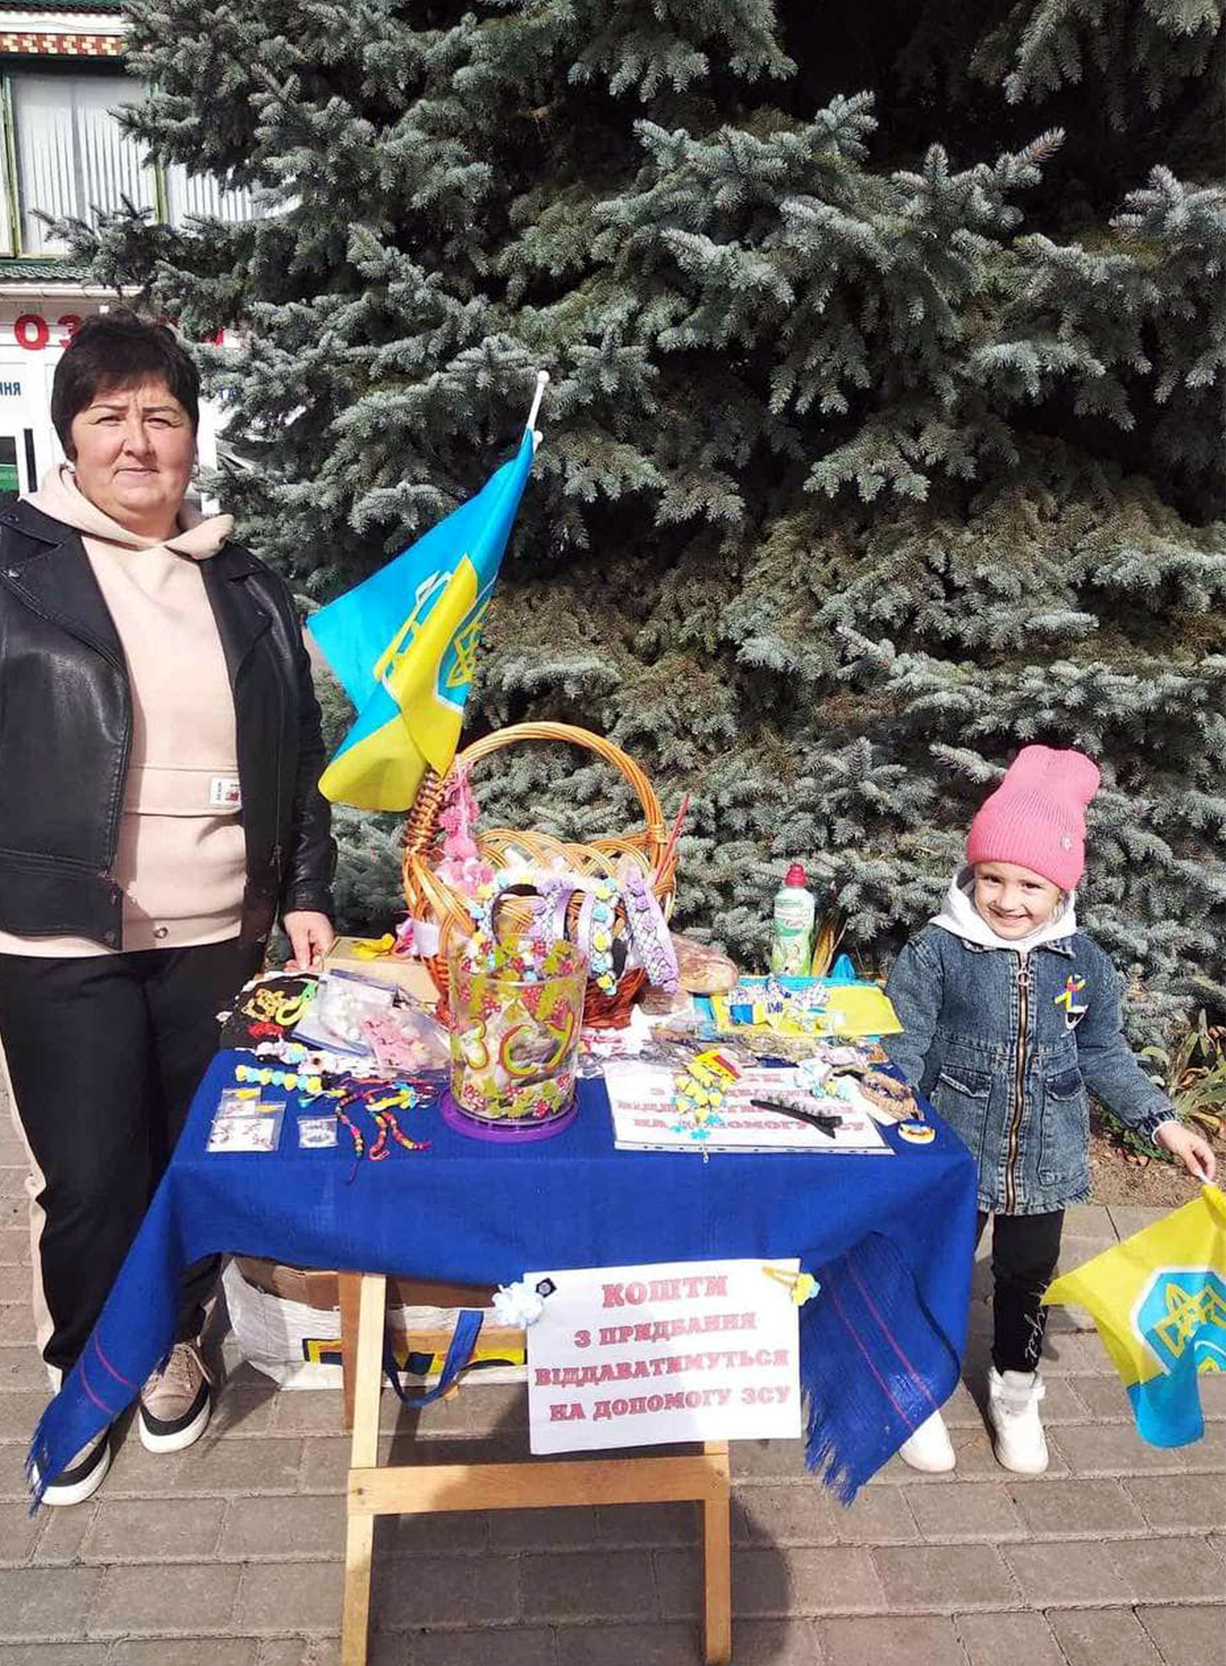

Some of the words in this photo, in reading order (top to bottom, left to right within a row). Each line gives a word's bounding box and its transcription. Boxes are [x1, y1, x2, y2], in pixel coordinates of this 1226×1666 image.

[602, 1276, 728, 1308] КОШТИ
[573, 1329, 591, 1348] З
[599, 1312, 757, 1345] ПРИДБАННЯ
[534, 1349, 789, 1388] ВІДДАВАТИМУТЬСЯ
[549, 1403, 587, 1422] НА
[593, 1388, 732, 1421] ДОПОМОГУ
[741, 1386, 792, 1405] ЗСУ
